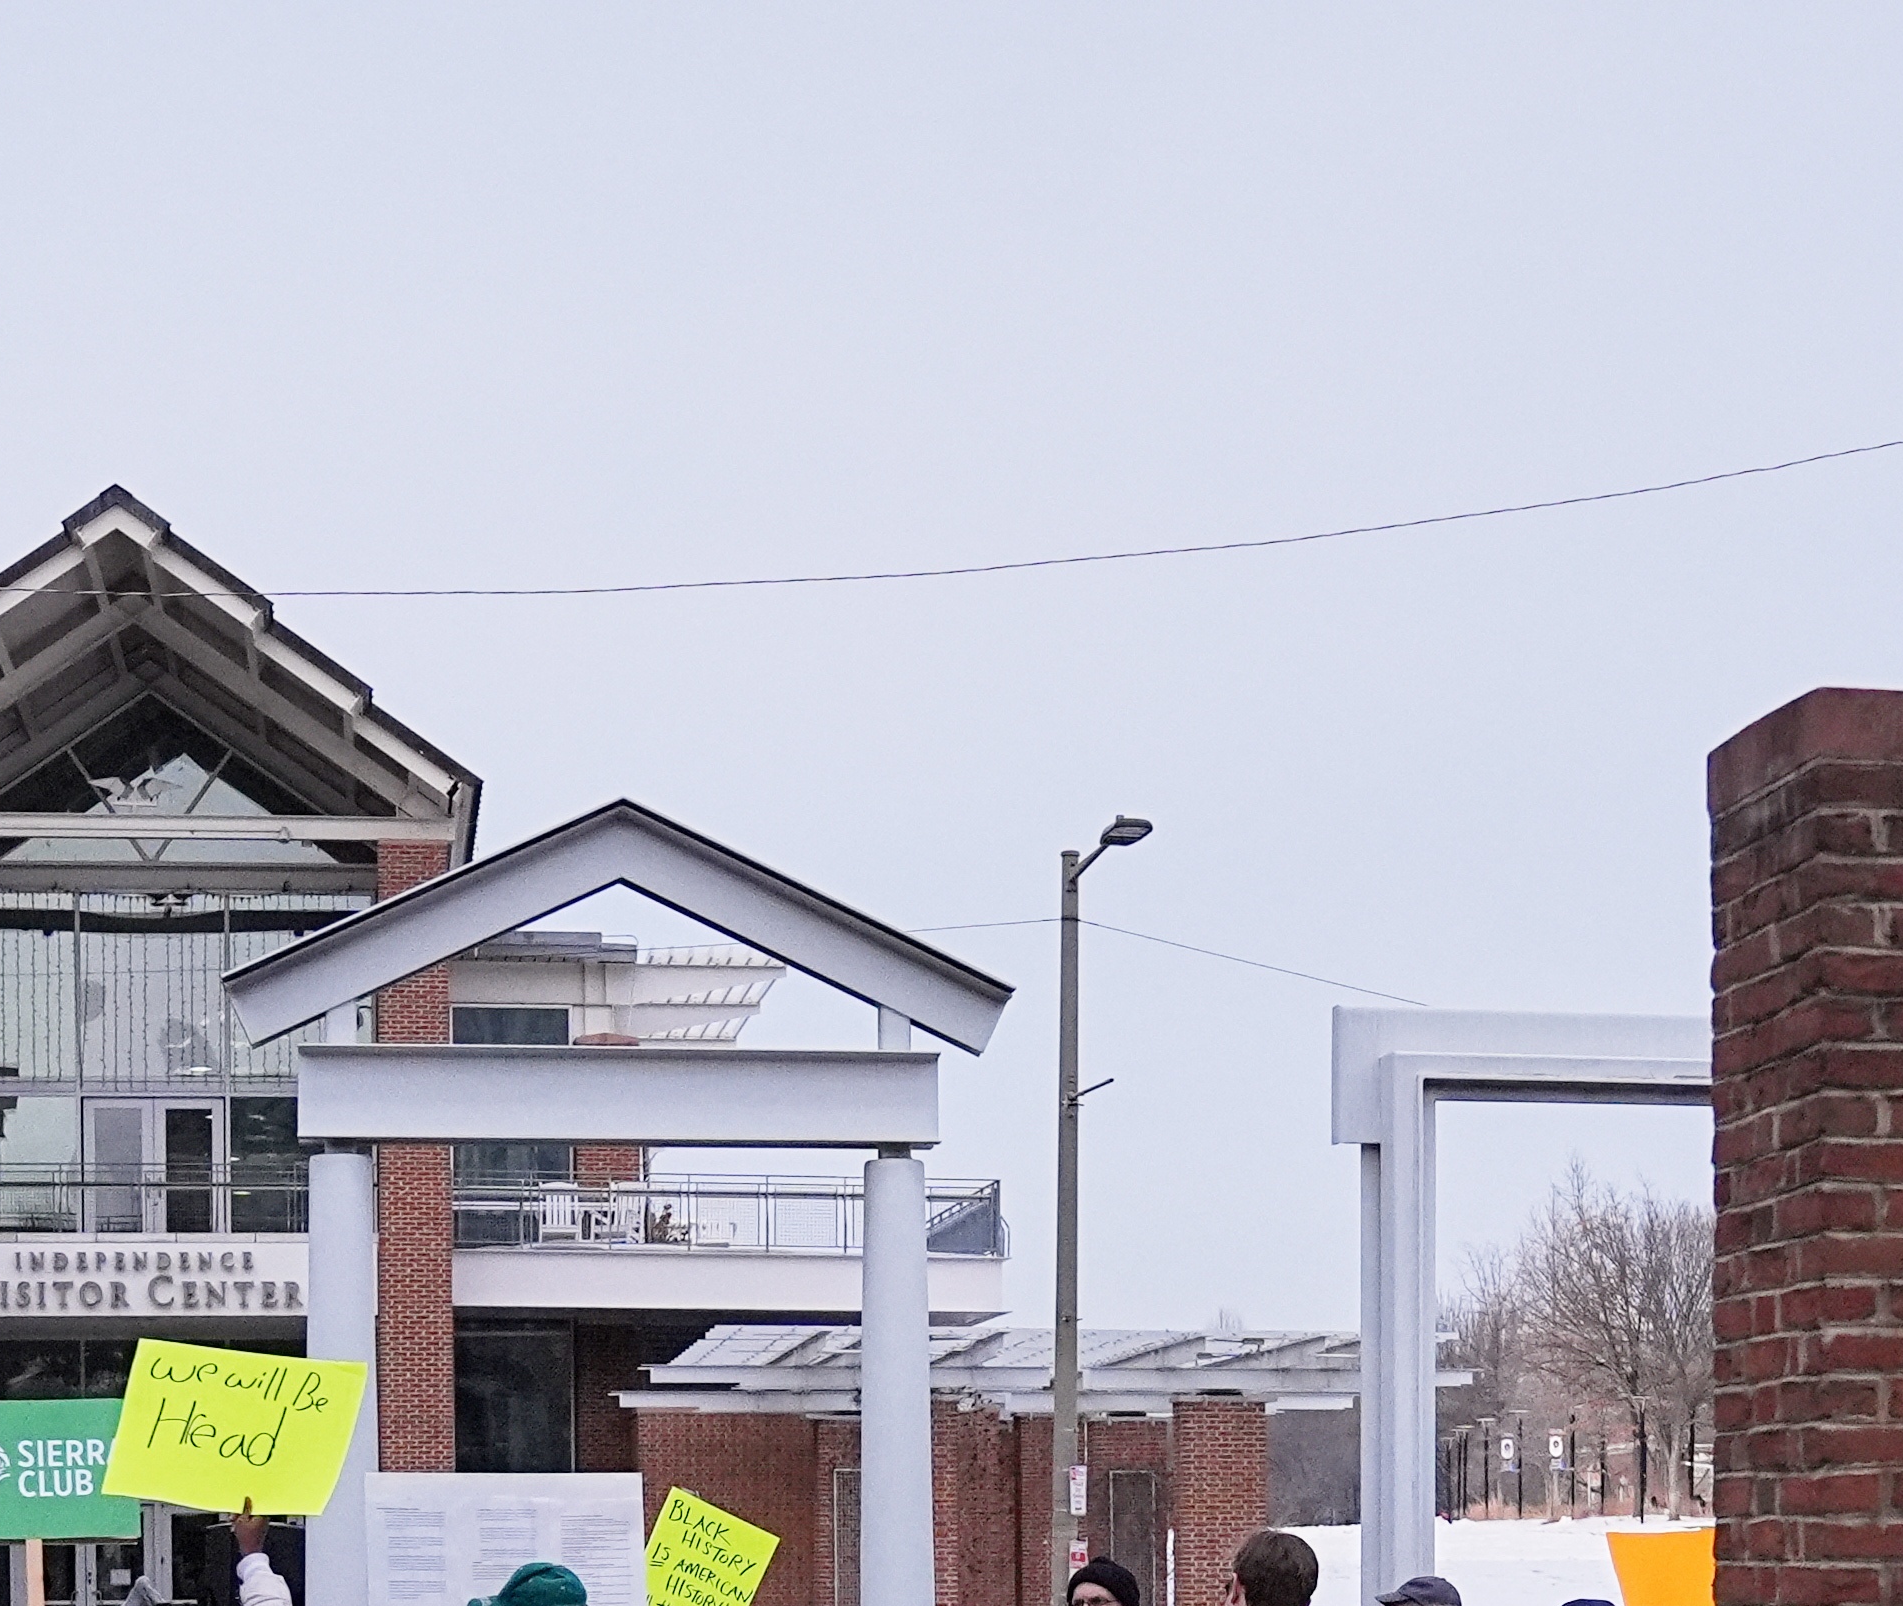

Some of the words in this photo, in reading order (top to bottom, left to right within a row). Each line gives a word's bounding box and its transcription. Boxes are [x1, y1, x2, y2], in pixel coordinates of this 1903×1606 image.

[14, 1251, 254, 1272] INDEPENDENCE
[147, 1274, 303, 1311] CENTER
[225, 1366, 287, 1402] will
[292, 1371, 328, 1414] Be
[18, 1470, 94, 1499] CLUB
[668, 1499, 731, 1547] BLACK
[651, 1541, 672, 1563] IS
[672, 1558, 754, 1603] AMERICAN
[681, 1530, 758, 1577] HISTORY
